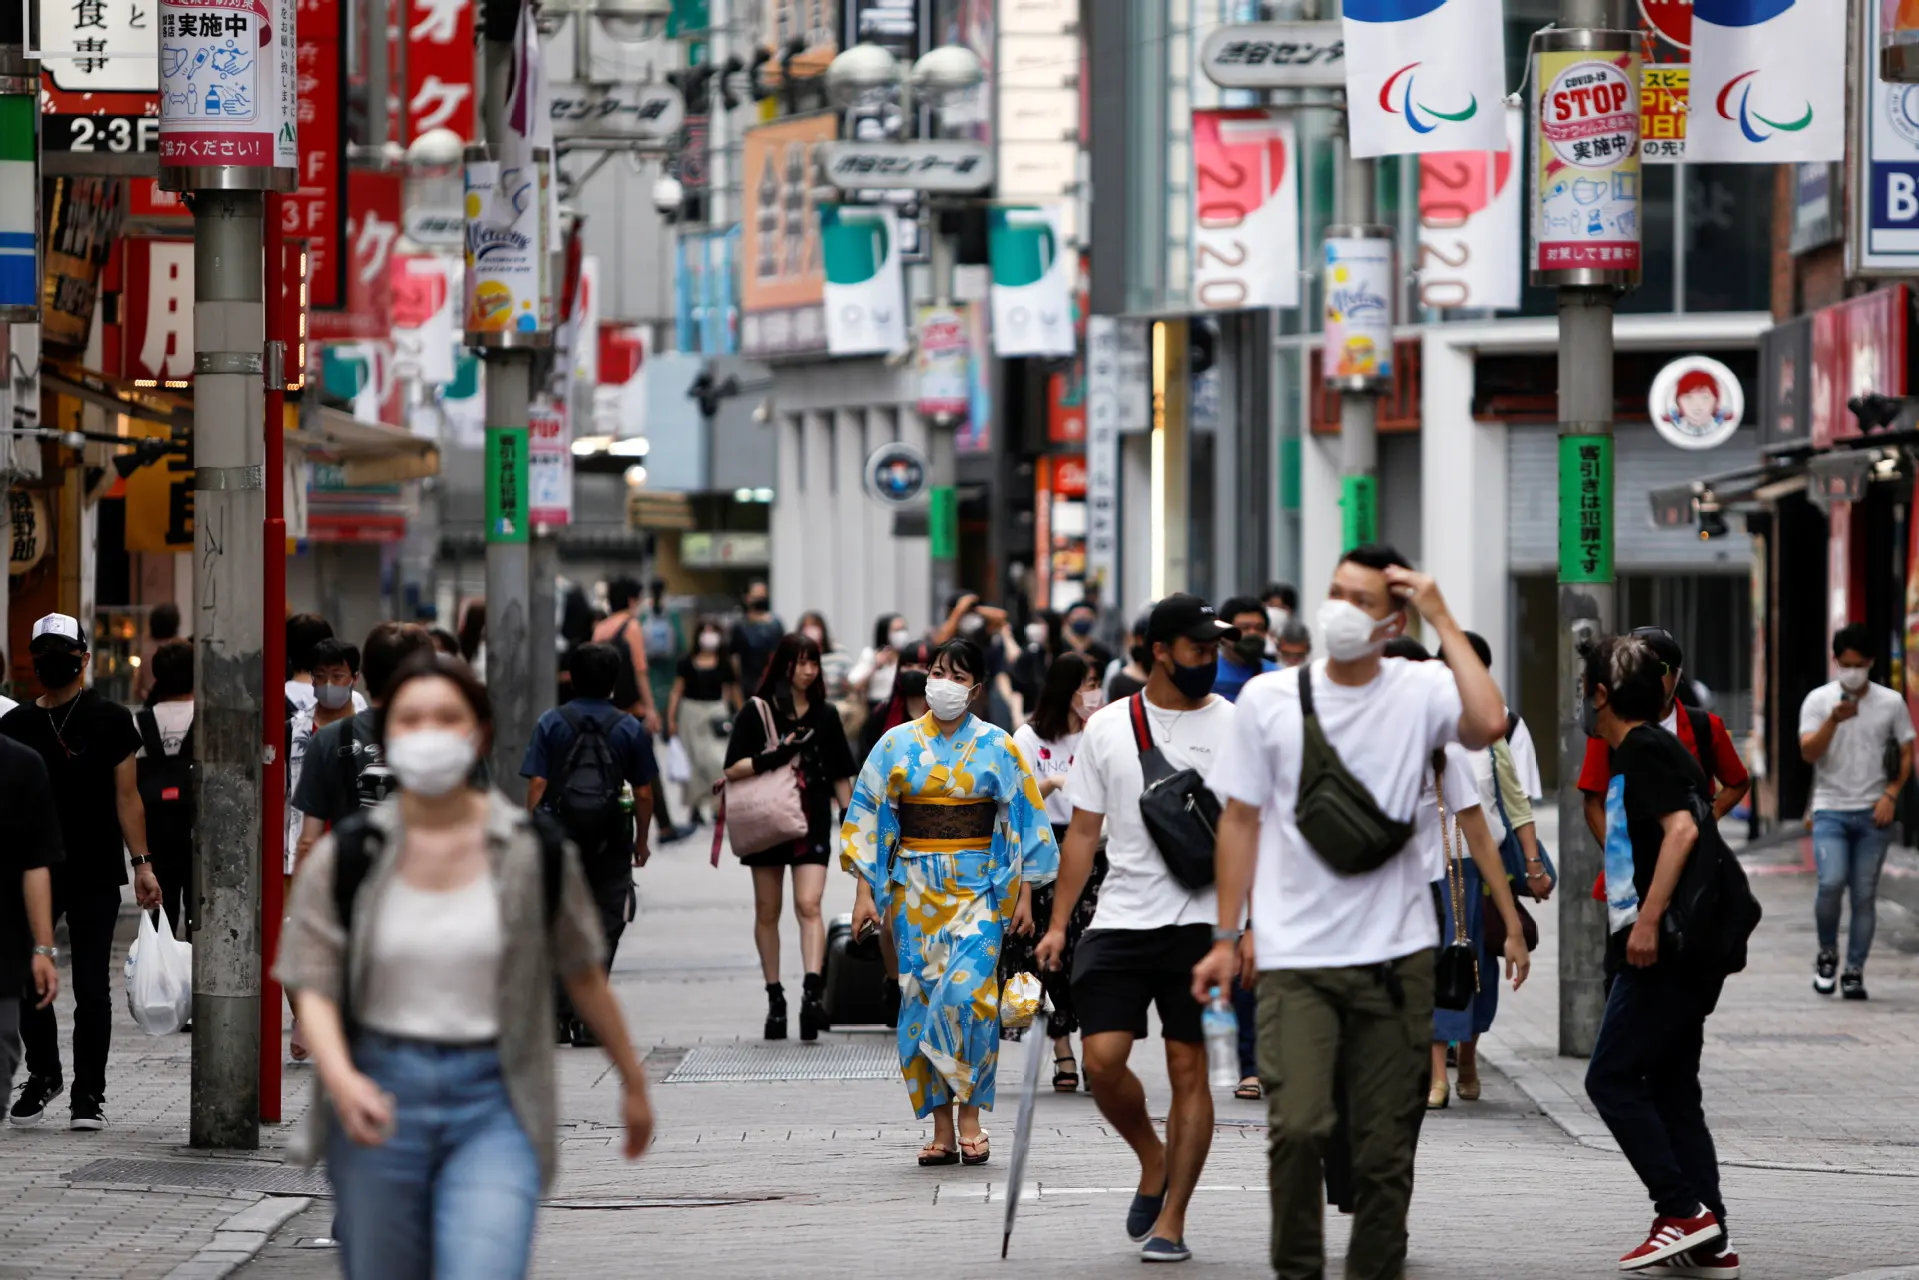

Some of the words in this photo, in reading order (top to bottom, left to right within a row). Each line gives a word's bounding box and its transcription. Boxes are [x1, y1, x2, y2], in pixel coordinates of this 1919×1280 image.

[129, 3, 146, 28] と
[178, 12, 248, 37] 実施中
[1565, 71, 1607, 88] COVID-19
[1553, 82, 1627, 121] STOP
[1573, 133, 1627, 160] 実施中
[1887, 172, 1919, 222] B
[1197, 162, 1247, 307] 2020
[1420, 161, 1471, 307] 2020
[1579, 445, 1601, 574] 客引きは犯罪です
